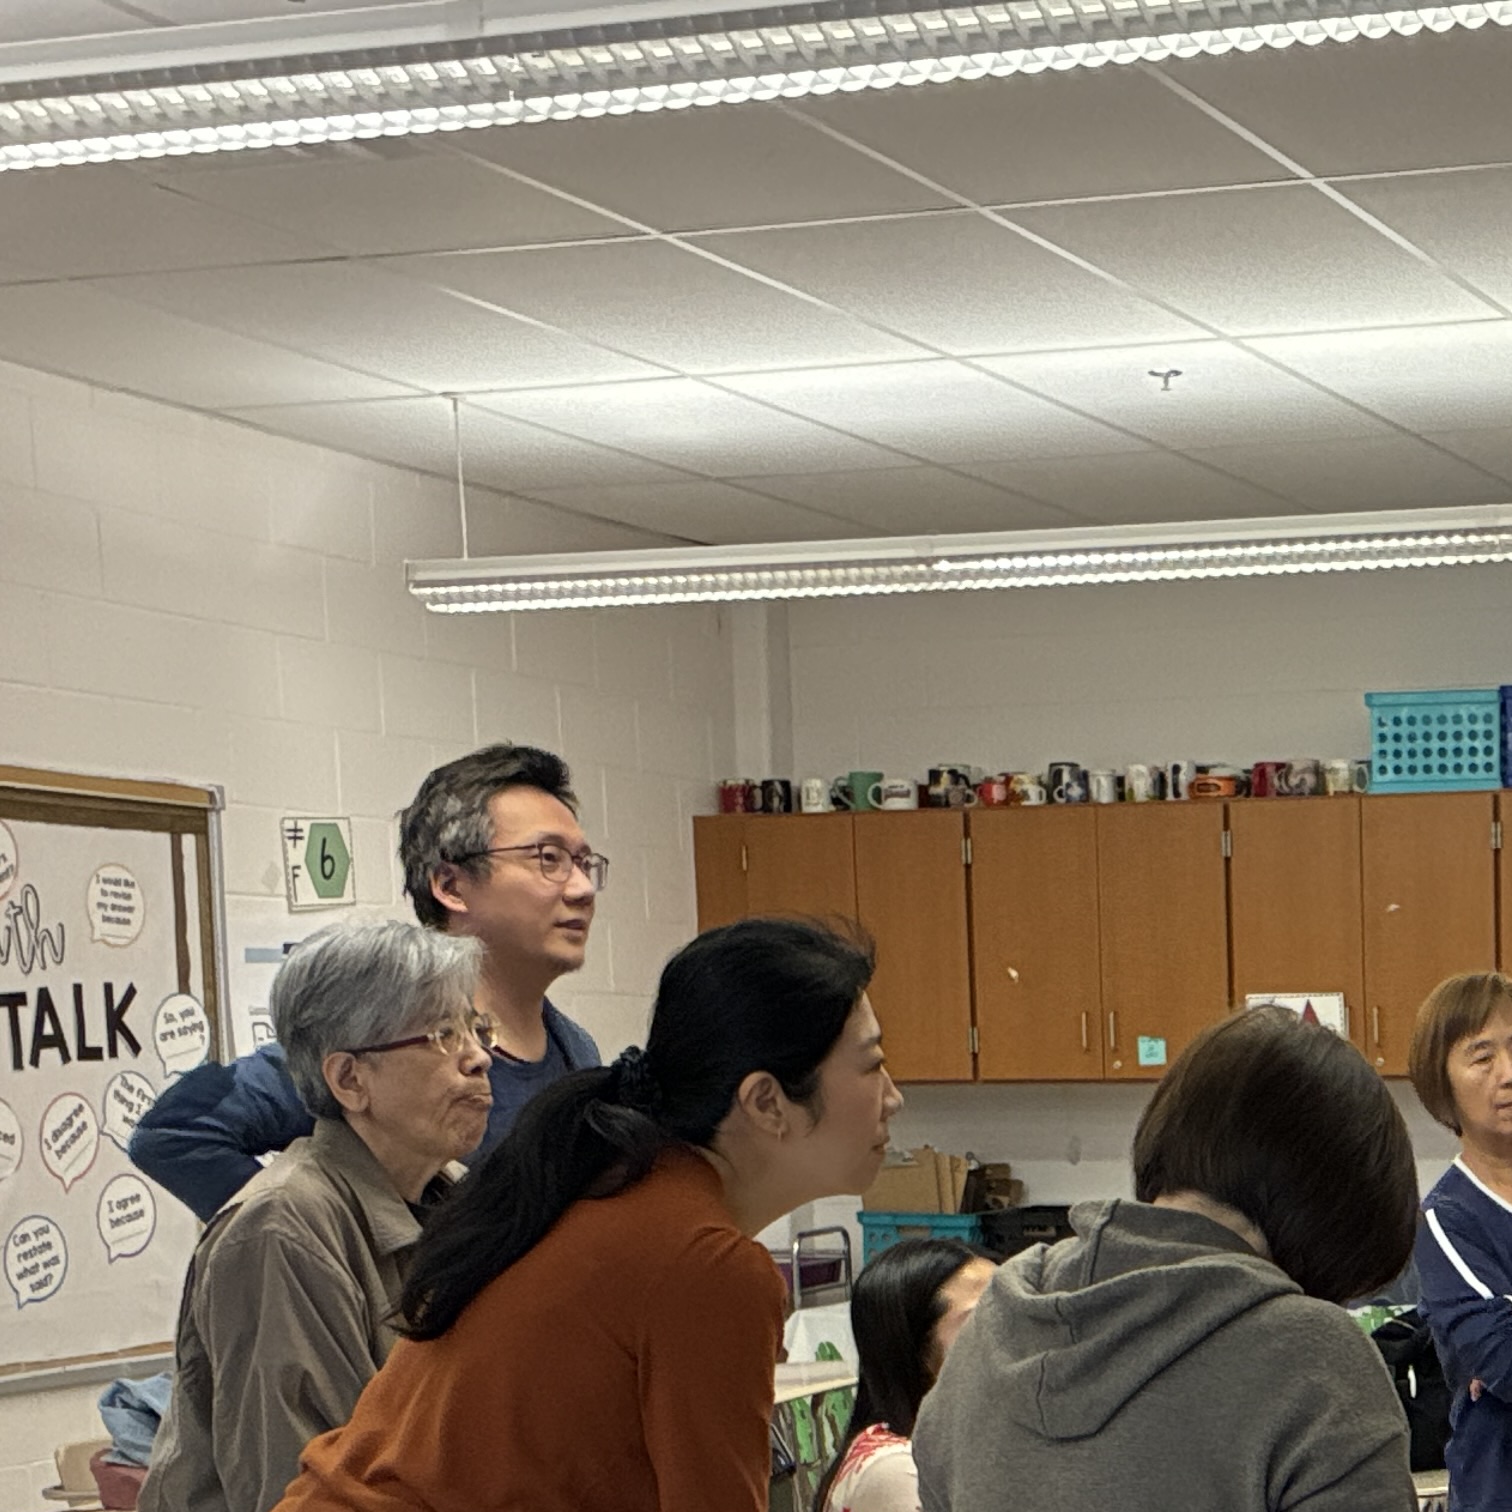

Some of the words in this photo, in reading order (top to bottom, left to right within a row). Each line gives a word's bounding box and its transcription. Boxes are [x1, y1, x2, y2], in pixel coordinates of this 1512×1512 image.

[320, 837, 336, 881] 6
[0, 982, 143, 1071] TALK
[107, 1200, 115, 1214] I
[115, 1193, 142, 1211] agree
[13, 1232, 32, 1248] Can
[32, 1224, 51, 1241] you
[17, 1240, 54, 1263] restate
[16, 1262, 41, 1281] what
